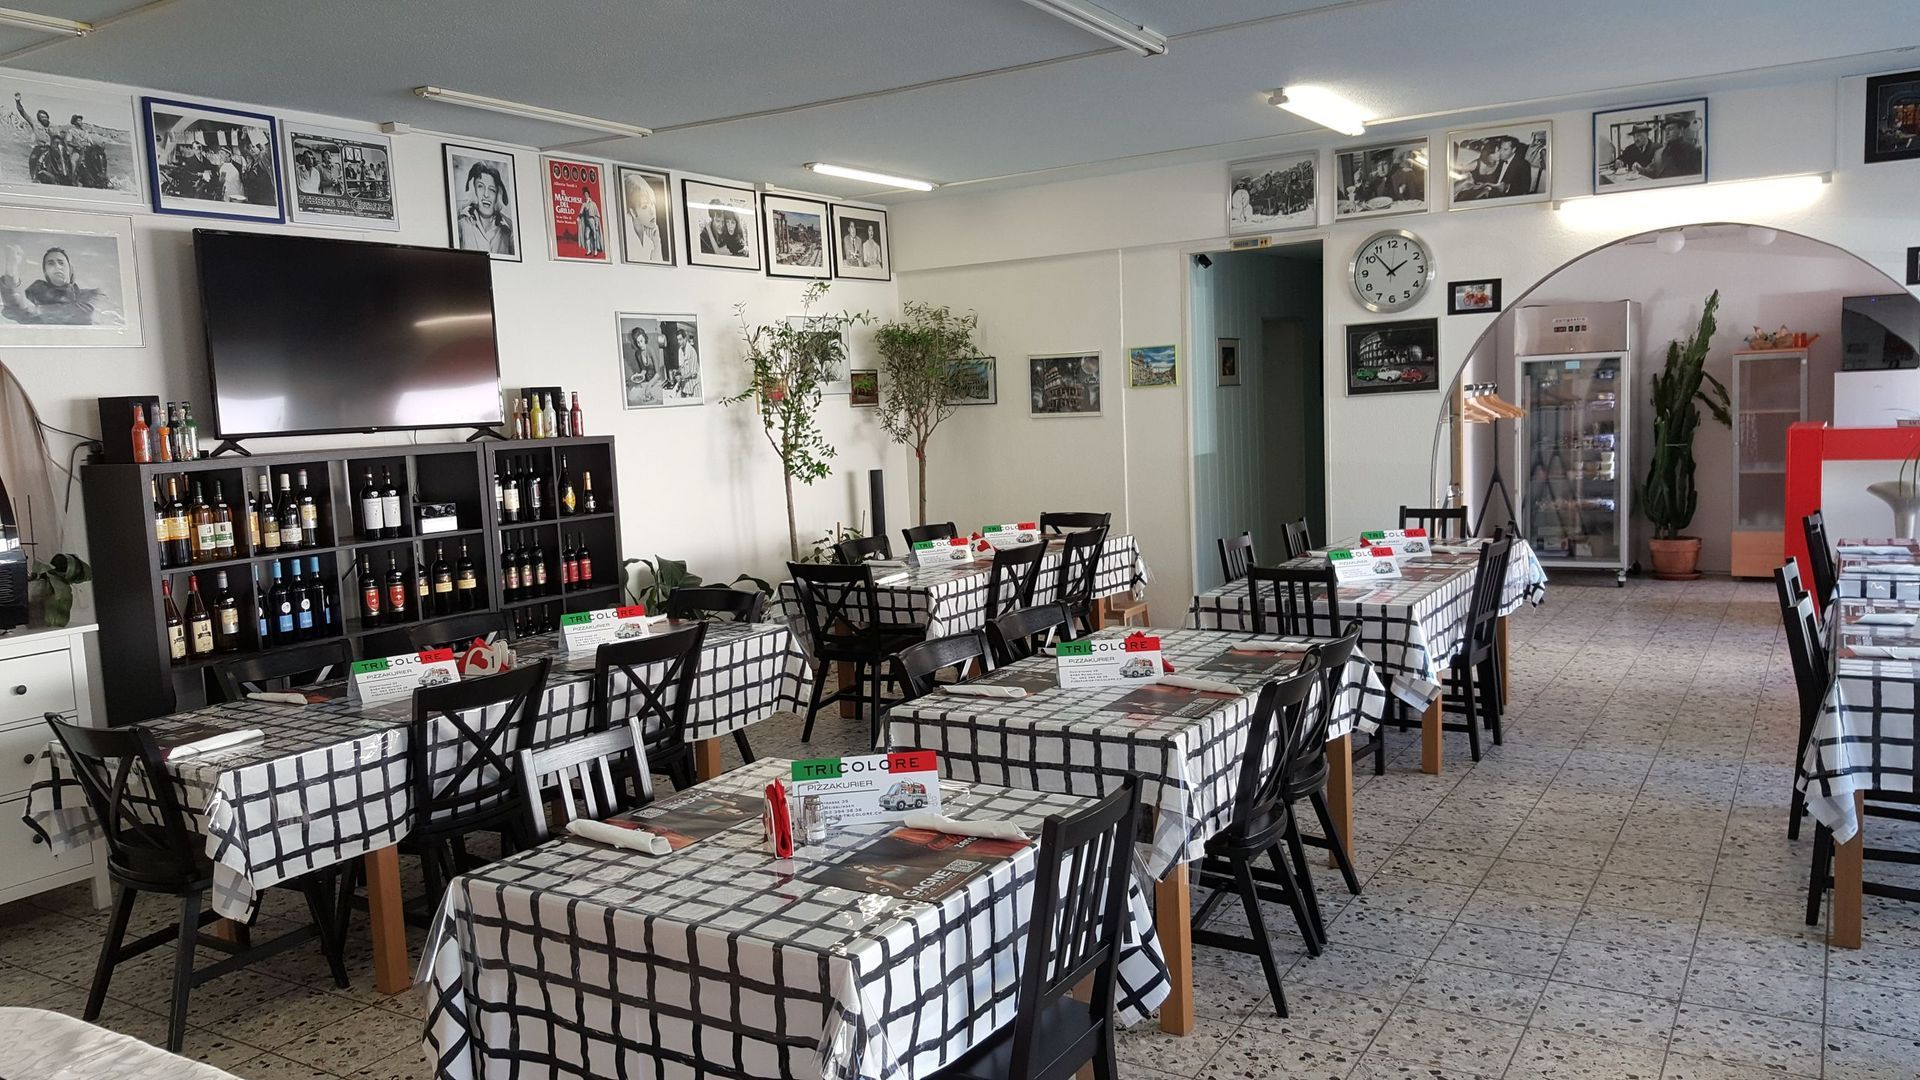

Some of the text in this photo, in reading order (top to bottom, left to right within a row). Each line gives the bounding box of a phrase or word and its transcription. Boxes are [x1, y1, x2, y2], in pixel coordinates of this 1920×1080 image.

[1387, 240, 1398, 249] 12
[1403, 242, 1408, 251] 1
[1374, 245, 1383, 254] 11
[1365, 255, 1376, 264] 10
[1412, 251, 1421, 260] 2
[1361, 269, 1369, 278] 9
[1417, 265, 1424, 274] 3
[1365, 283, 1373, 292] 8
[1412, 280, 1419, 288] 4
[1375, 292, 1383, 301] 7
[1388, 294, 1396, 304] 6
[1403, 290, 1411, 299] 5
[970, 543, 976, 552] 2
[568, 608, 634, 624] TRICOLORE
[1065, 640, 1148, 654] TRICOLORE
[361, 652, 441, 671] TRICOLORE
[490, 655, 495, 669] 1
[1068, 656, 1115, 664] PIZZAKURIER
[803, 757, 920, 777] TRICOLORE
[807, 779, 873, 792] PIZZAKURIER
[902, 869, 954, 898] GAGNE
